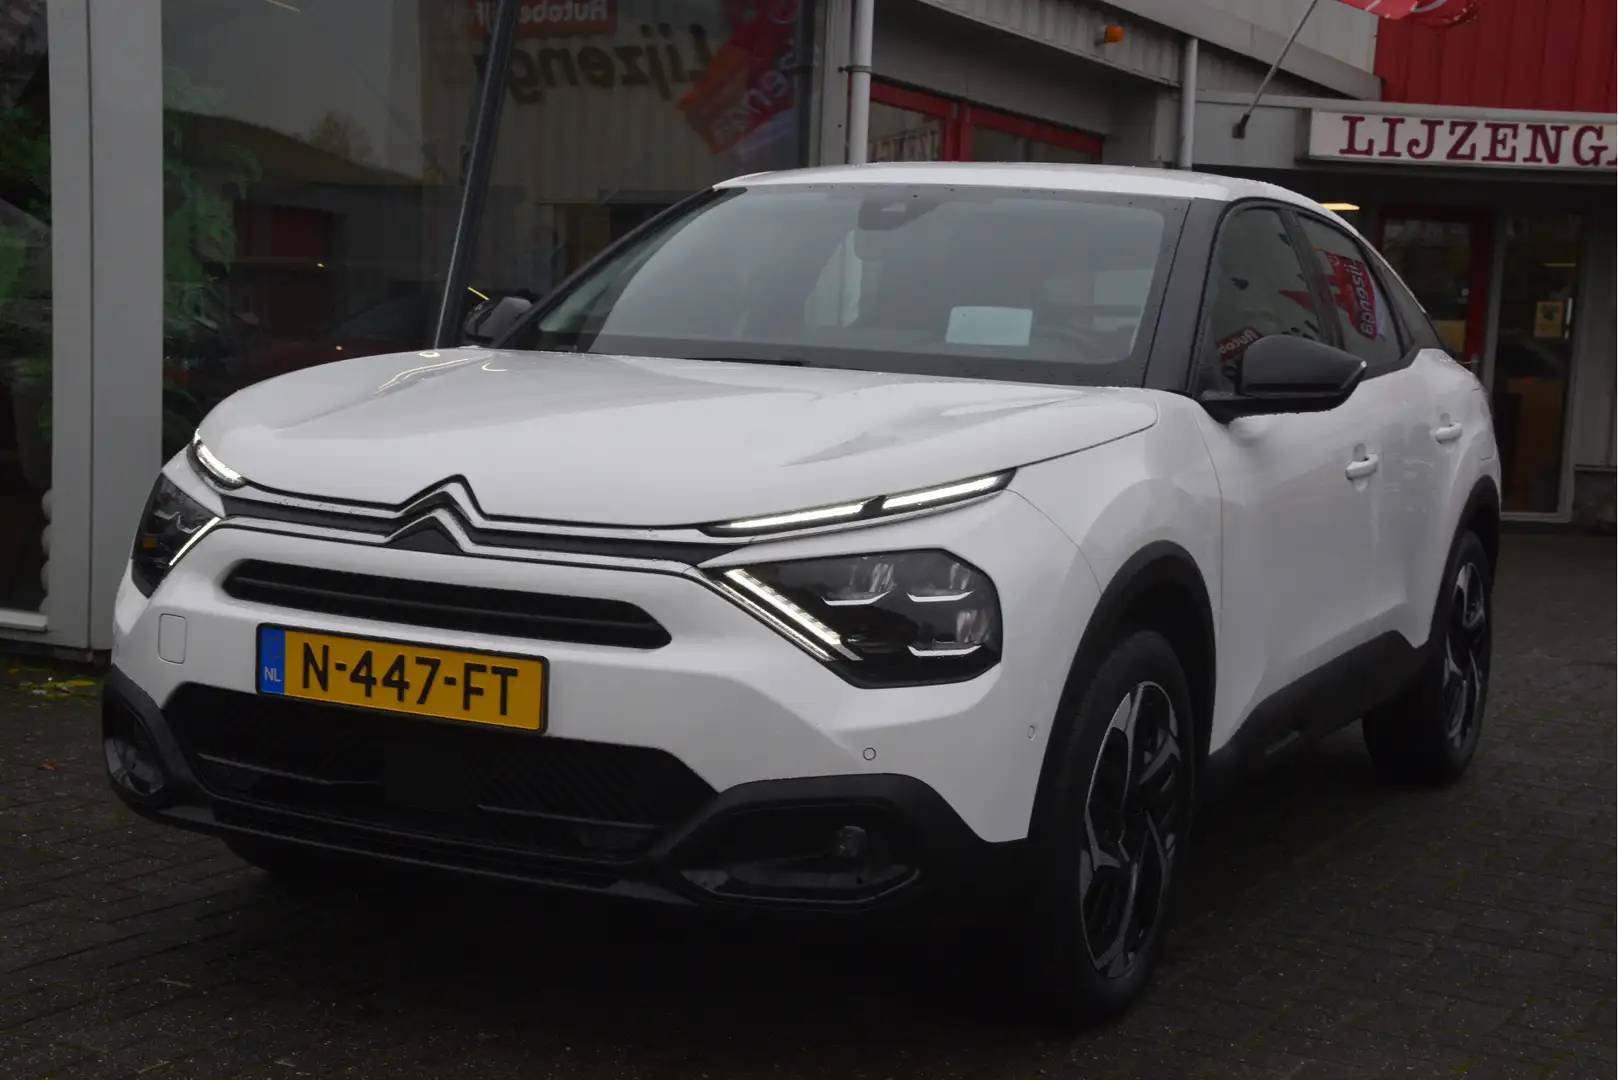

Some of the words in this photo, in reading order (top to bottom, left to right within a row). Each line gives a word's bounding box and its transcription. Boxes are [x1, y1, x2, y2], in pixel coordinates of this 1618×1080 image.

[1339, 115, 1617, 166] LIJZENG
[264, 665, 281, 683] NL
[303, 642, 518, 715] N-447-FT
